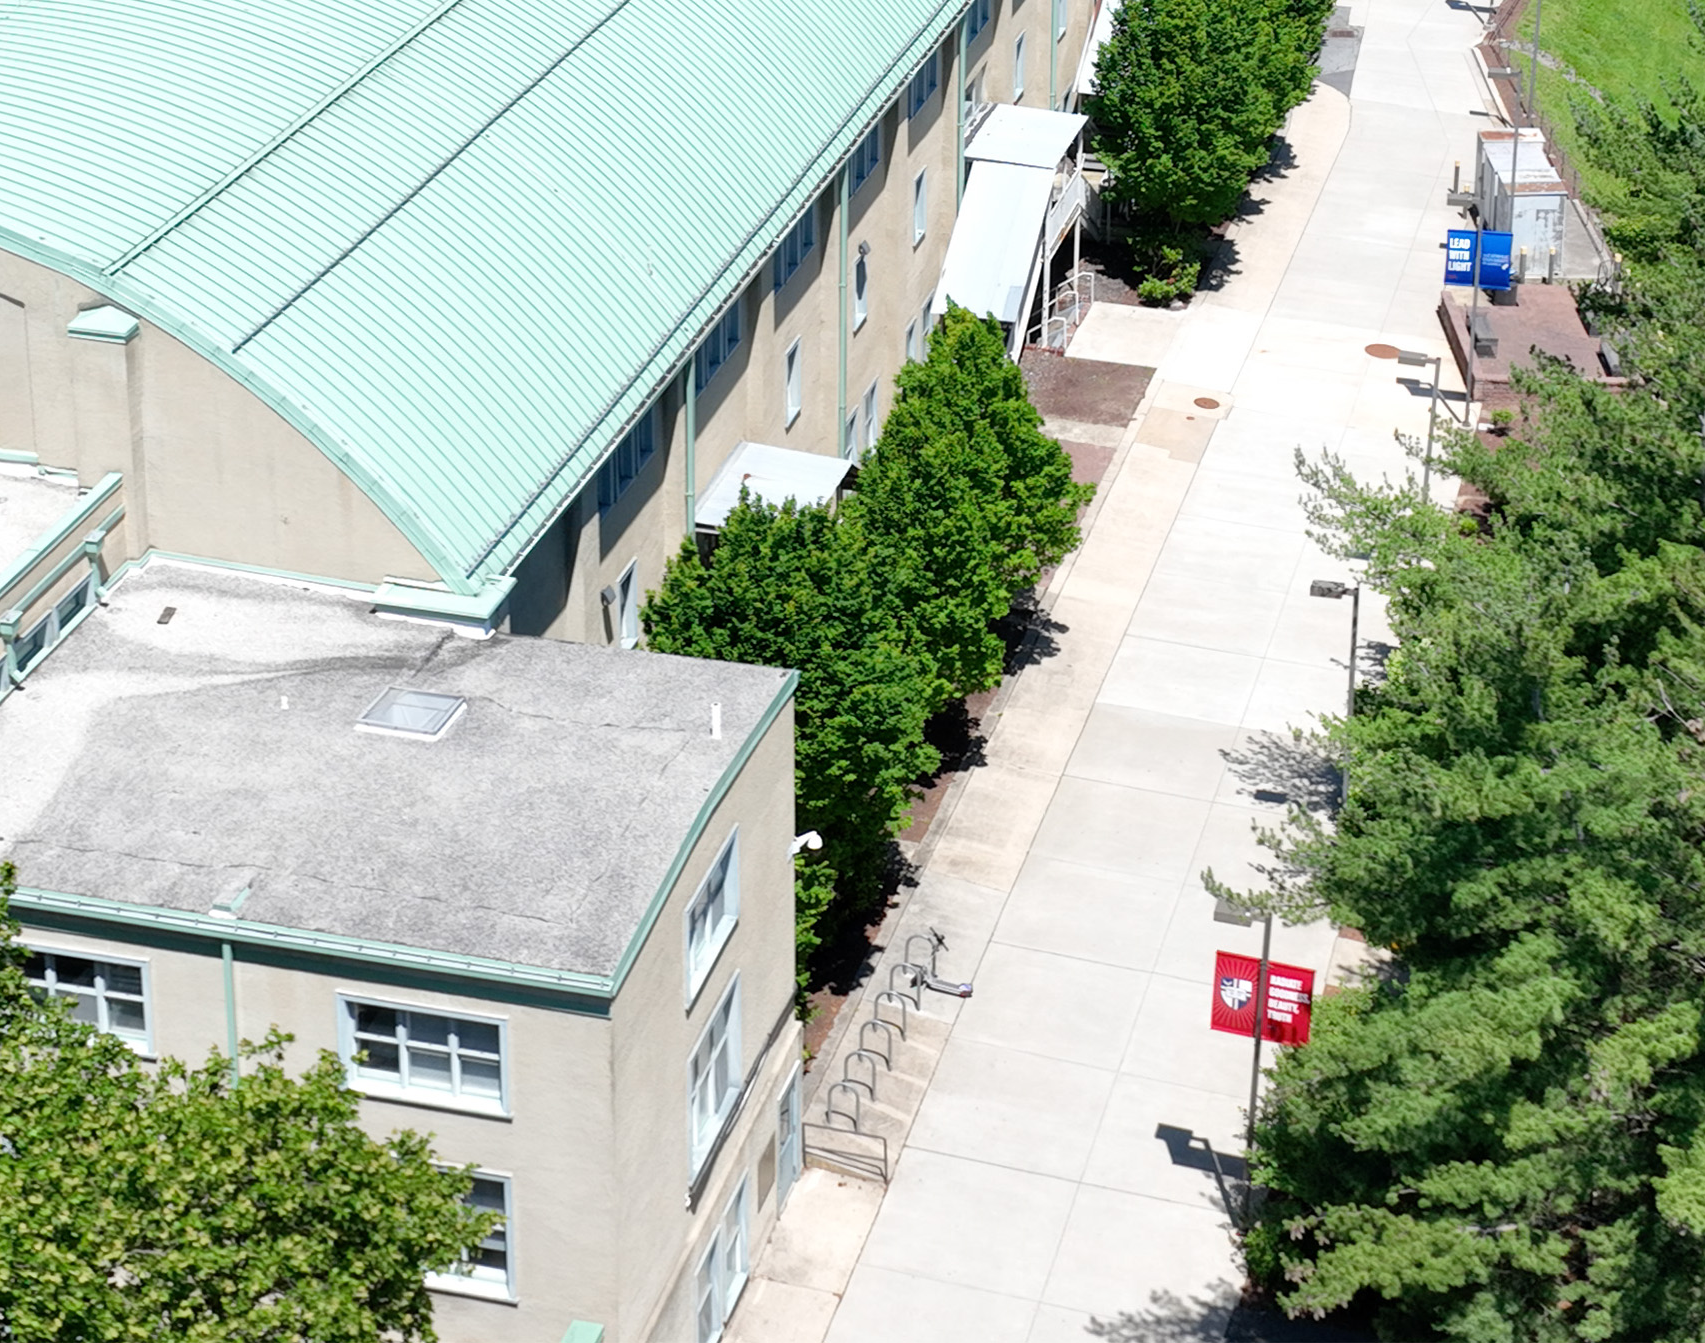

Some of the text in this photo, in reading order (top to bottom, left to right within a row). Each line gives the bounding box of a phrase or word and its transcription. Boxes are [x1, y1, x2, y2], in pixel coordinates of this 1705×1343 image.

[1449, 237, 1471, 249] LEAD
[1449, 250, 1470, 261] WITH
[1447, 261, 1472, 272] LIGHT
